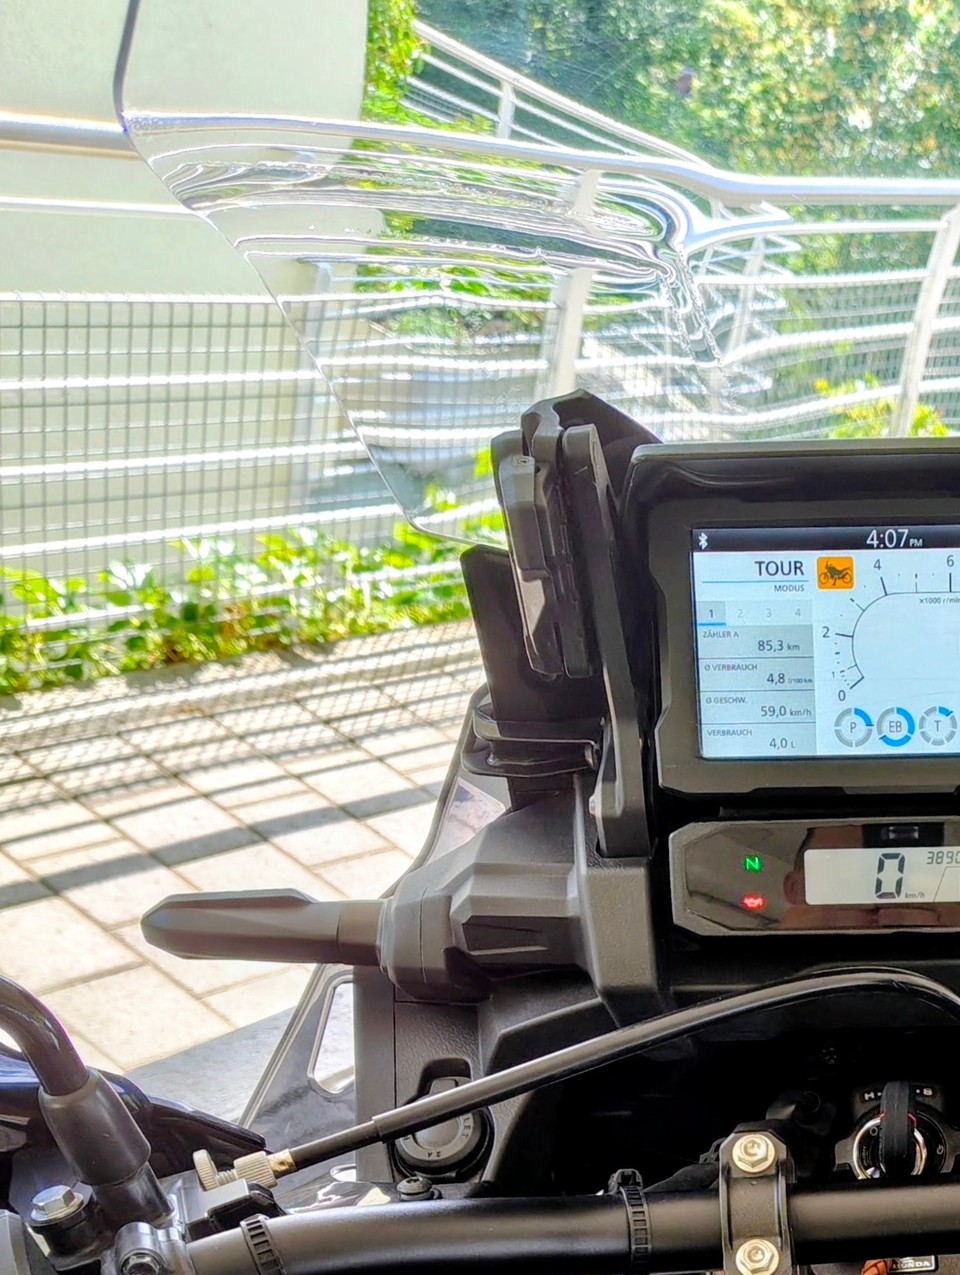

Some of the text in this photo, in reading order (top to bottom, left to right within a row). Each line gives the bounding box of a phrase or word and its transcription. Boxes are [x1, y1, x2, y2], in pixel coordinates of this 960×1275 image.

[866, 529, 923, 549] 4:07 PM
[873, 559, 882, 570] 4
[946, 555, 955, 568] 6
[754, 560, 805, 577] TOUR
[774, 584, 805, 593] MODUS
[708, 609, 714, 618] 1
[737, 609, 743, 618] 2
[702, 629, 732, 639] ZÄHLER
[822, 626, 830, 638] 2
[757, 640, 800, 653] 85,3 km
[712, 663, 758, 671] VERBRAUCH
[766, 673, 785, 686] 4,8
[713, 696, 748, 704] GESCHW.
[838, 689, 846, 702] 0
[760, 705, 812, 718] 59,0 km/h
[849, 721, 857, 733] P
[888, 720, 902, 733] EB
[934, 720, 942, 732] T
[707, 728, 753, 737] VERBRAUCH
[769, 738, 788, 750] 4,0
[744, 855, 762, 873] N
[874, 852, 906, 900] 0
[905, 891, 925, 900] km/h
